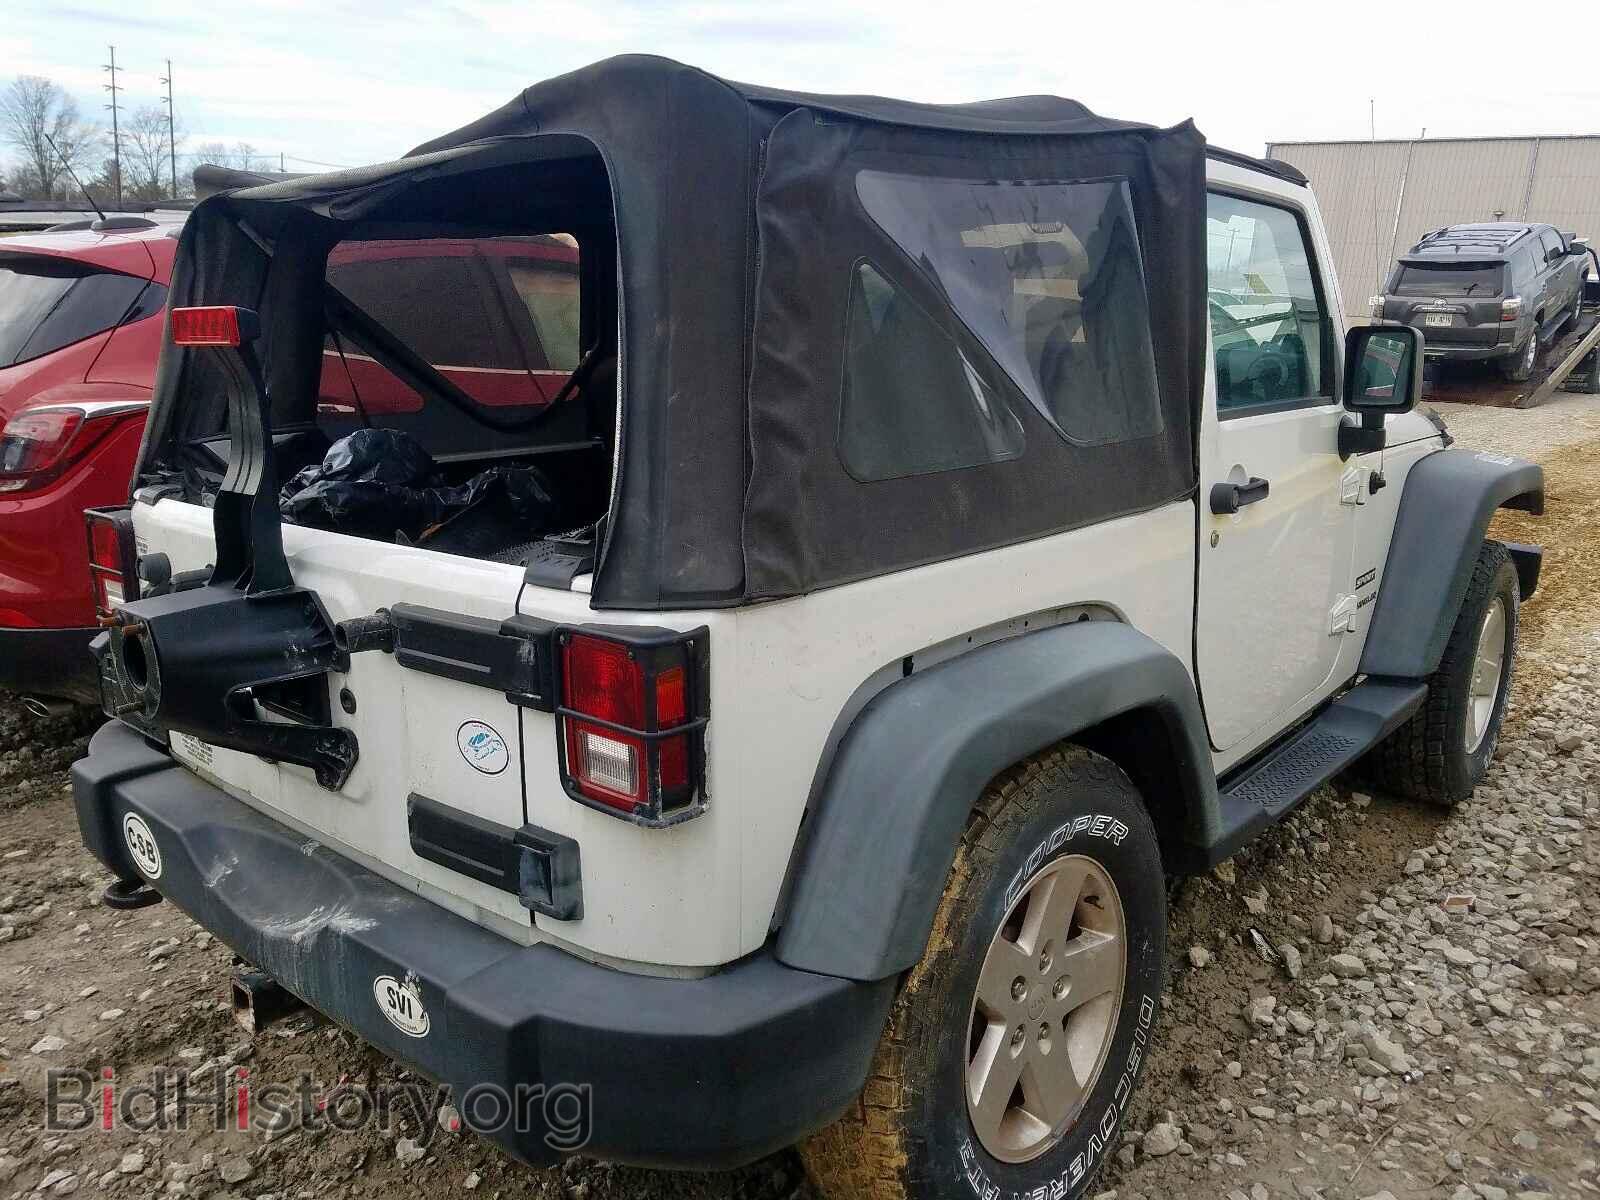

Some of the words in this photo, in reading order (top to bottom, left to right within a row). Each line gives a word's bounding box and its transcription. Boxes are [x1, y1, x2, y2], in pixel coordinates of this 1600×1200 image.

[128, 826, 155, 864] CSB
[1004, 815, 1129, 911] COOPER
[387, 986, 412, 1019] SVI
